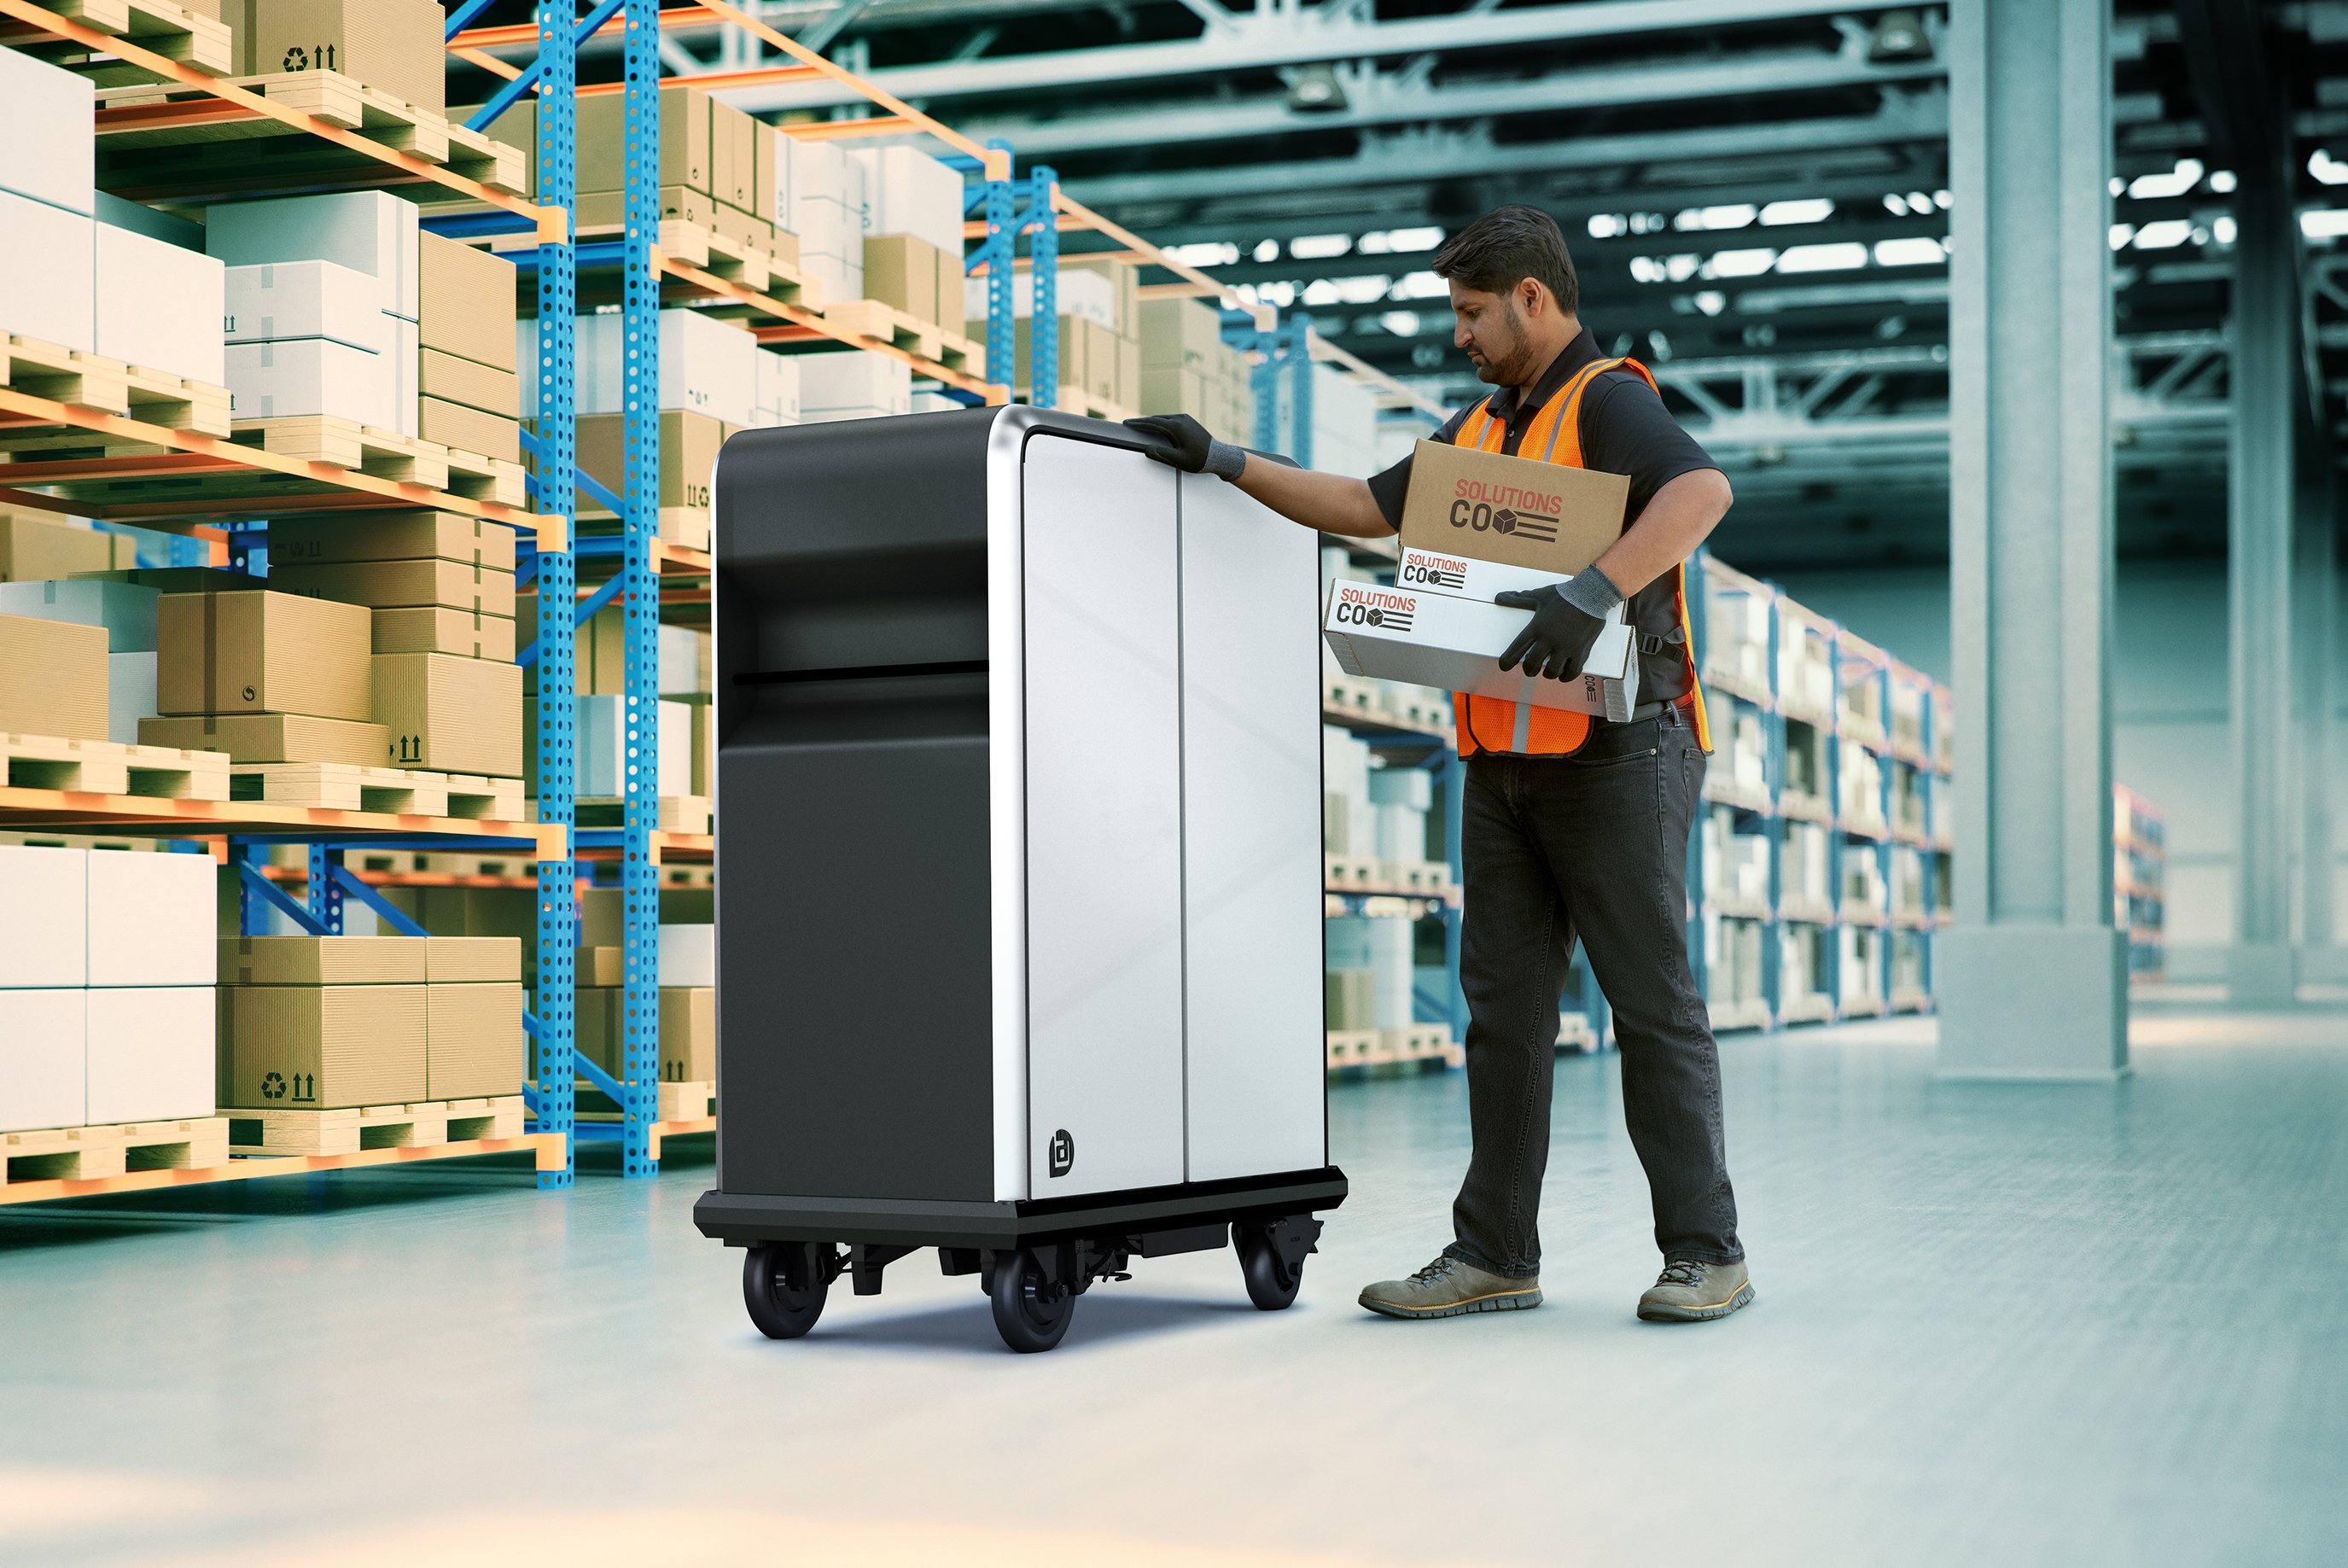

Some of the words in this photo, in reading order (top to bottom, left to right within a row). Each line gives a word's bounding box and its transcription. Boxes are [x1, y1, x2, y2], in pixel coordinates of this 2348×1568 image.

[1454, 478, 1563, 515] SOLUTIONS
[1407, 553, 1467, 574] SOLUTIONS
[1340, 588, 1417, 612] SOLUTIONS
